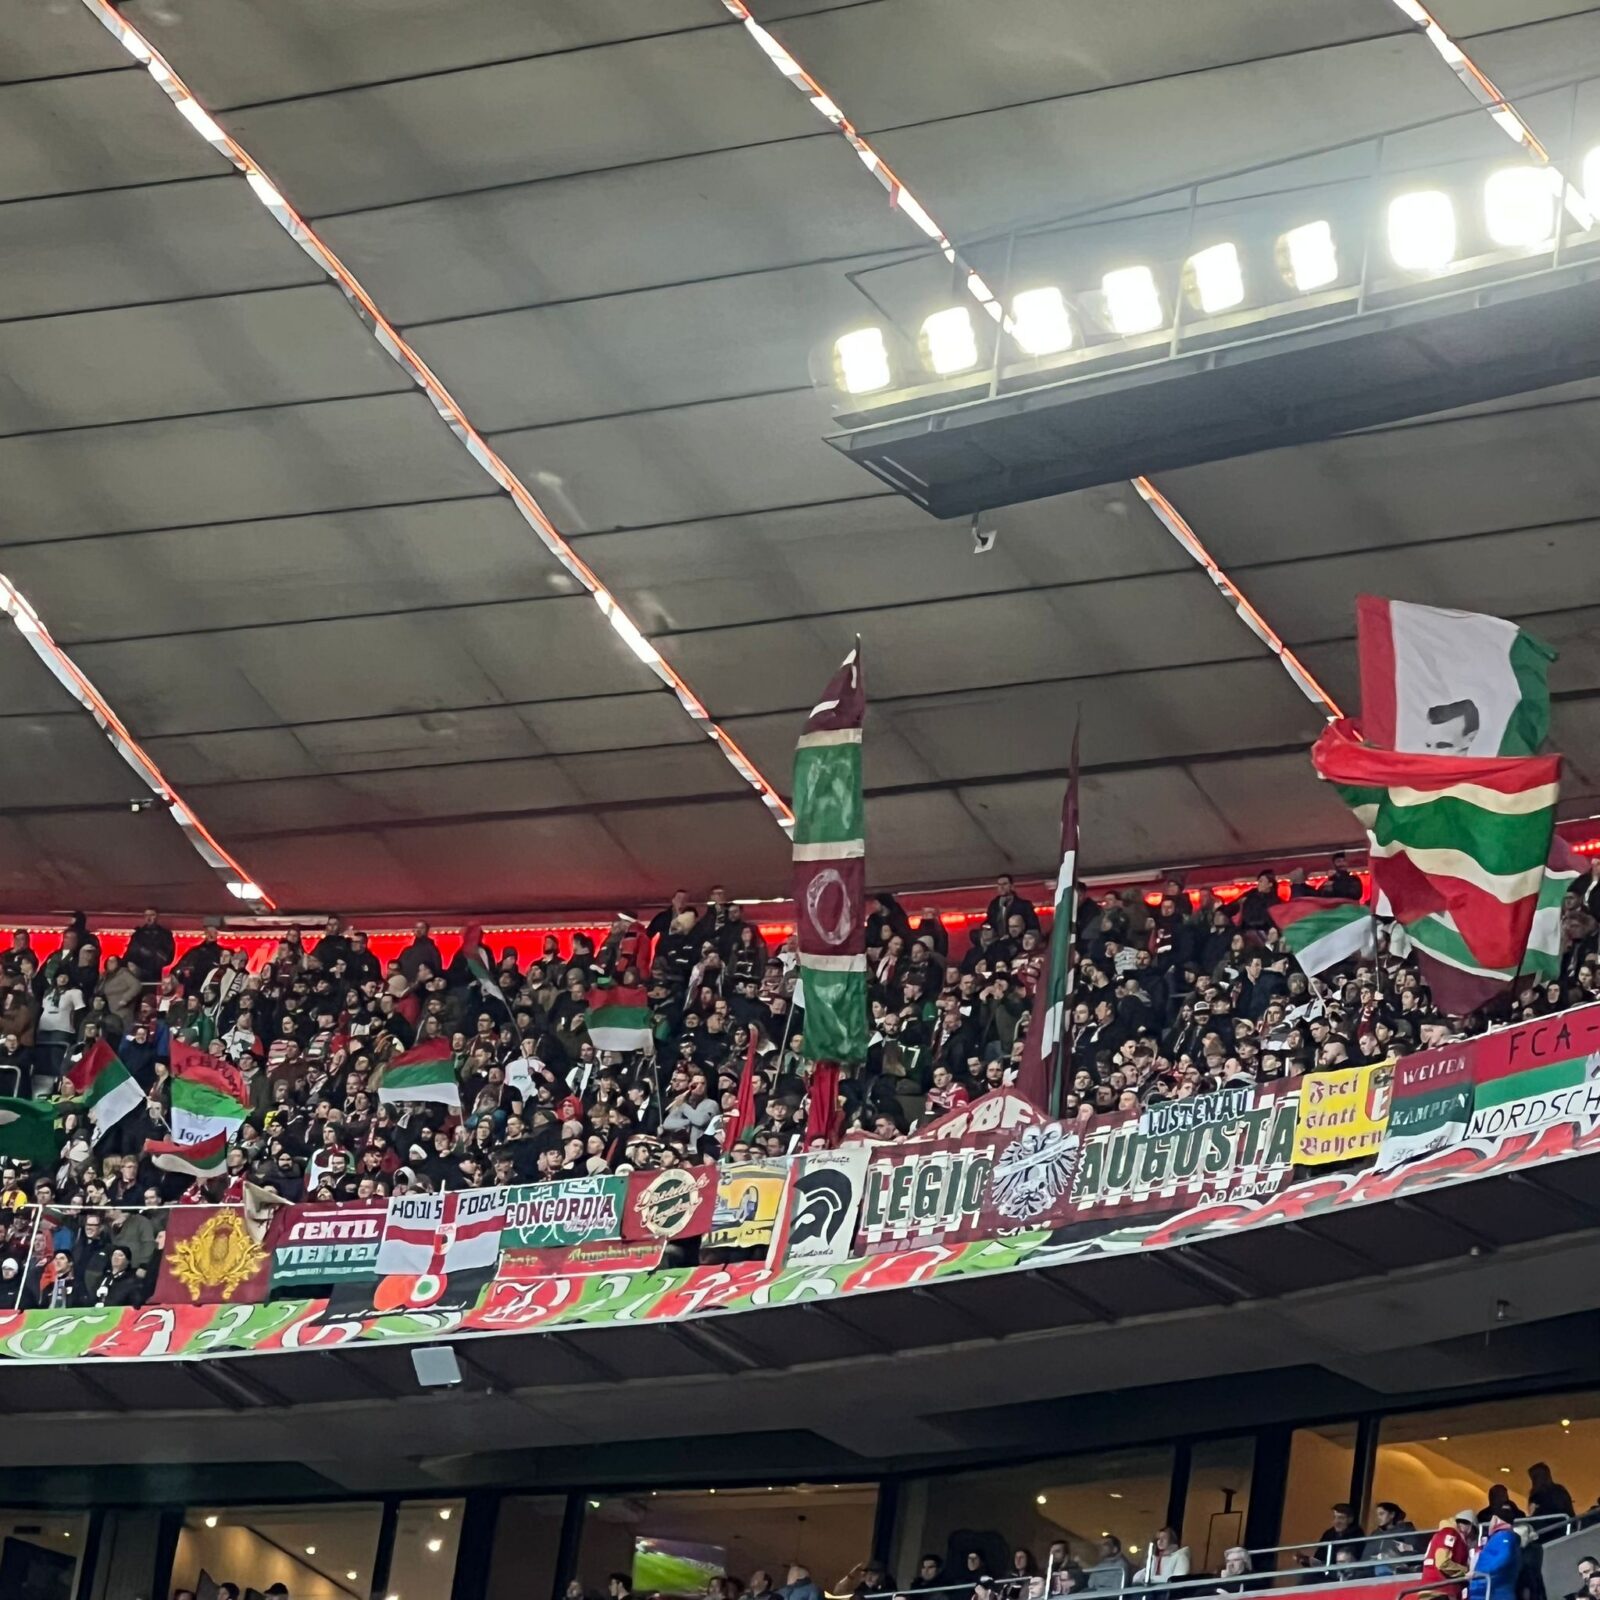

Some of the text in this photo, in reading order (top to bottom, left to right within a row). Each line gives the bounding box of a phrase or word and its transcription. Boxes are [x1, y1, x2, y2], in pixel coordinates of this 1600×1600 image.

[1508, 1023, 1571, 1065] FCA
[1309, 1074, 1359, 1105] Frei
[1147, 1088, 1249, 1137] LUSTENAU
[1299, 1128, 1383, 1157] Bayern
[864, 1103, 1299, 1228] LEGIO AUGUSTA
[503, 1195, 617, 1229] CONCORDIA
[288, 1219, 380, 1241] TEXTIL
[275, 1242, 379, 1267] VIERTEL
